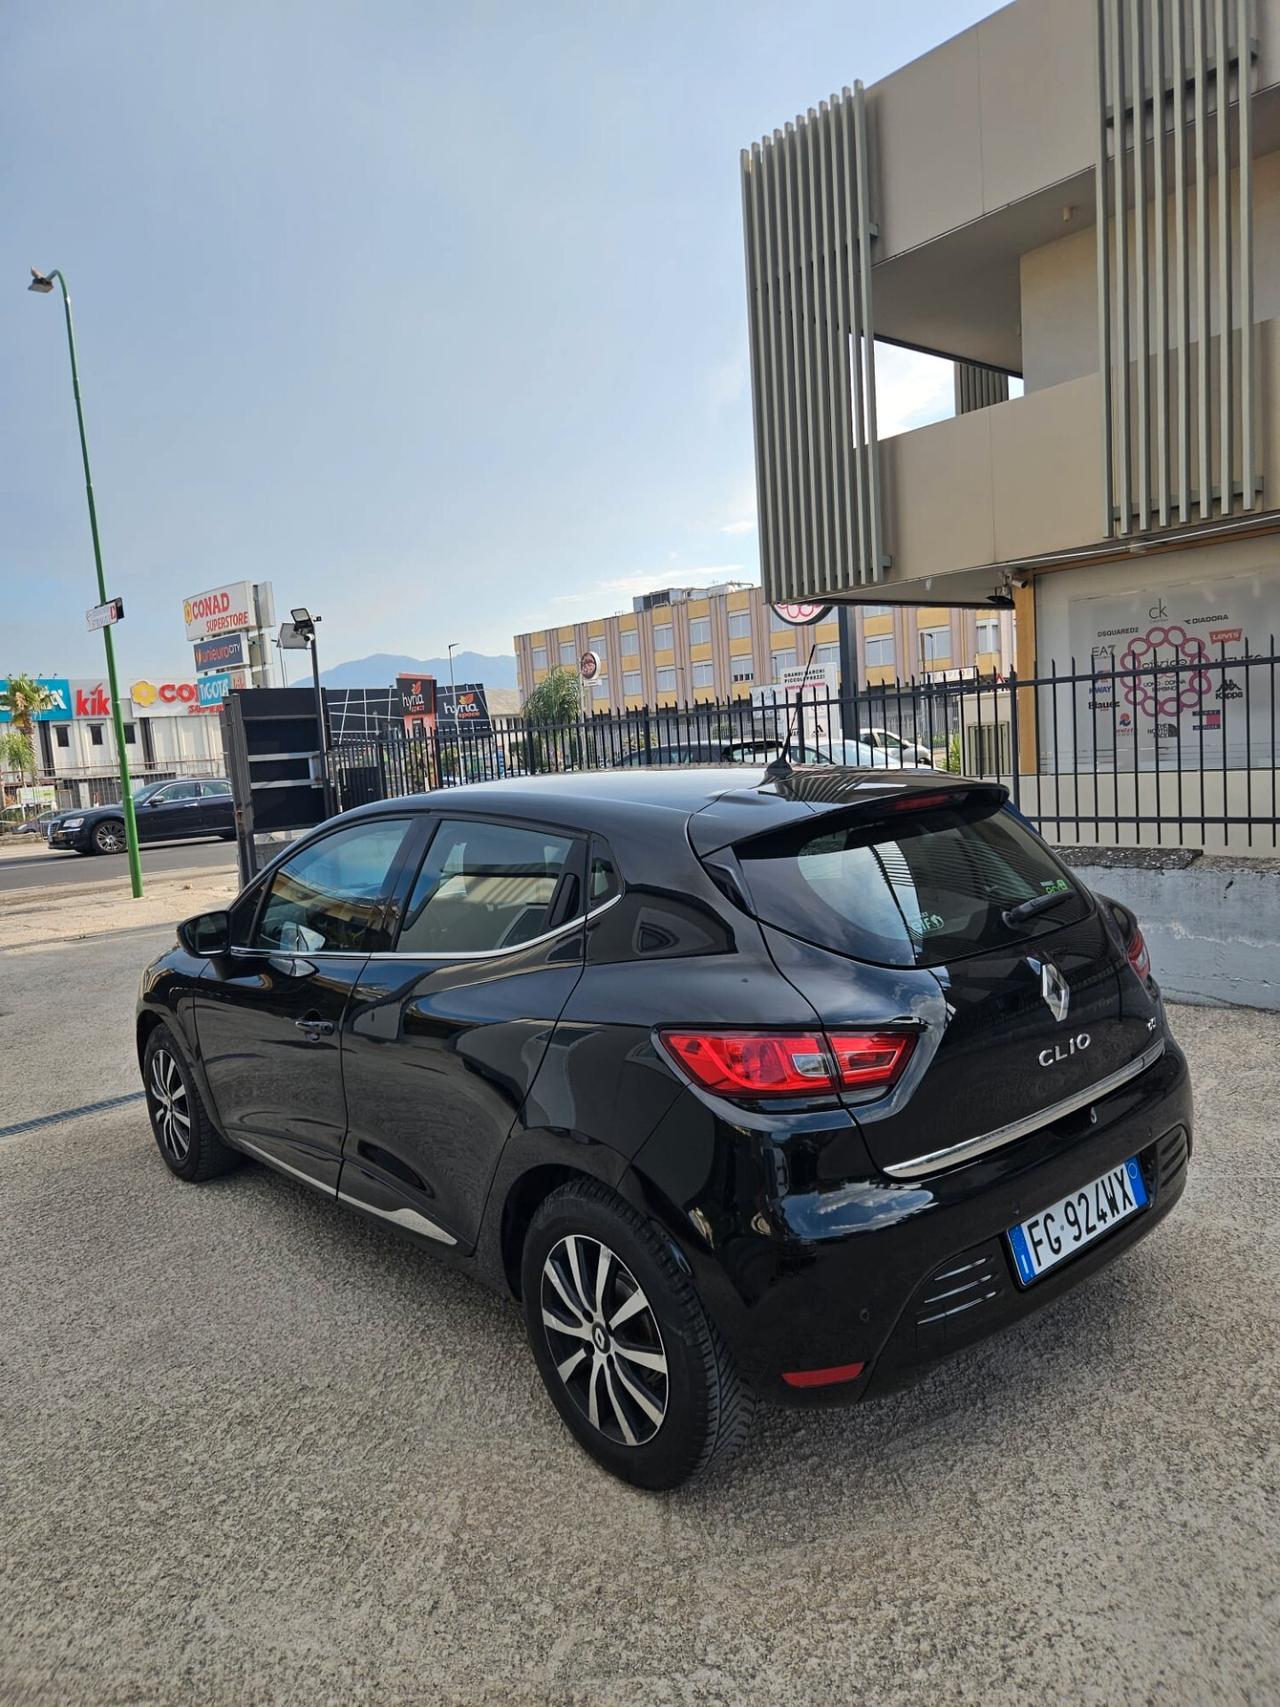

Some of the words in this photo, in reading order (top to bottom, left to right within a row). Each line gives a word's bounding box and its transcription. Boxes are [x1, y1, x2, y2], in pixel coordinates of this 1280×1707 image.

[191, 591, 230, 619] CONAD
[1148, 598, 1168, 619] ck
[206, 610, 249, 633] SUPERSTORE
[1192, 613, 1229, 624] DIADORA
[1097, 626, 1139, 638] DSQUARED2
[76, 684, 111, 716] kik
[1038, 1032, 1091, 1067] CLIO
[1027, 1212, 1063, 1267] FG
[1063, 1168, 1134, 1242] 924WX
